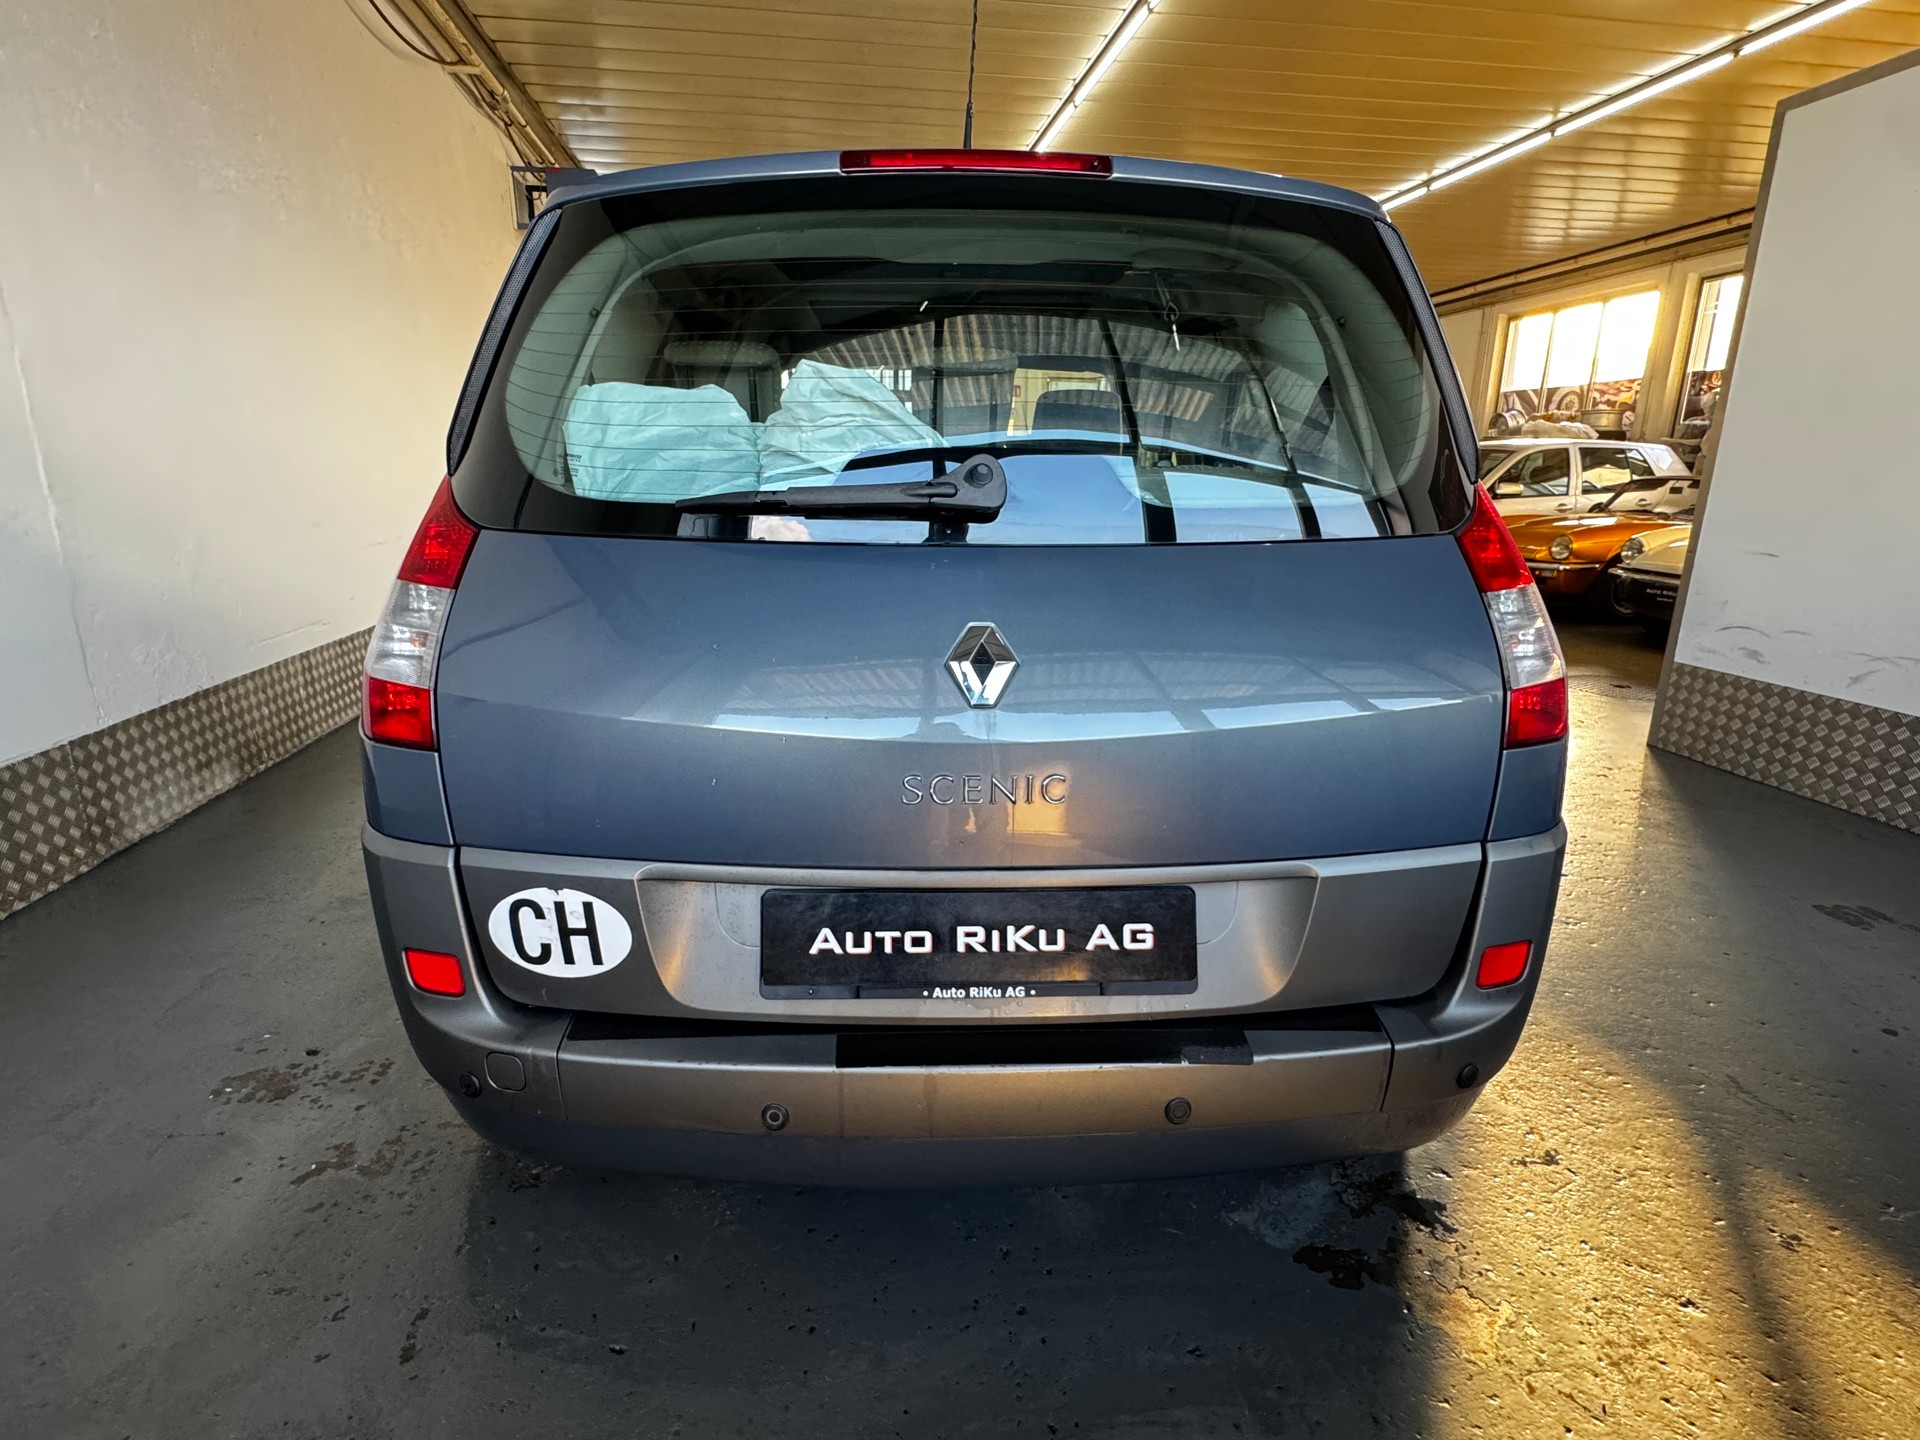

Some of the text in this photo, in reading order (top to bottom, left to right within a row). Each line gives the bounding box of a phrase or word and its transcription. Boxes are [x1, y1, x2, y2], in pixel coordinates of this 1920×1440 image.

[902, 774, 1066, 805] SCENIC
[509, 898, 604, 966] CH
[1085, 923, 1155, 951] AG
[932, 986, 1026, 999] Auto RiKu AG
